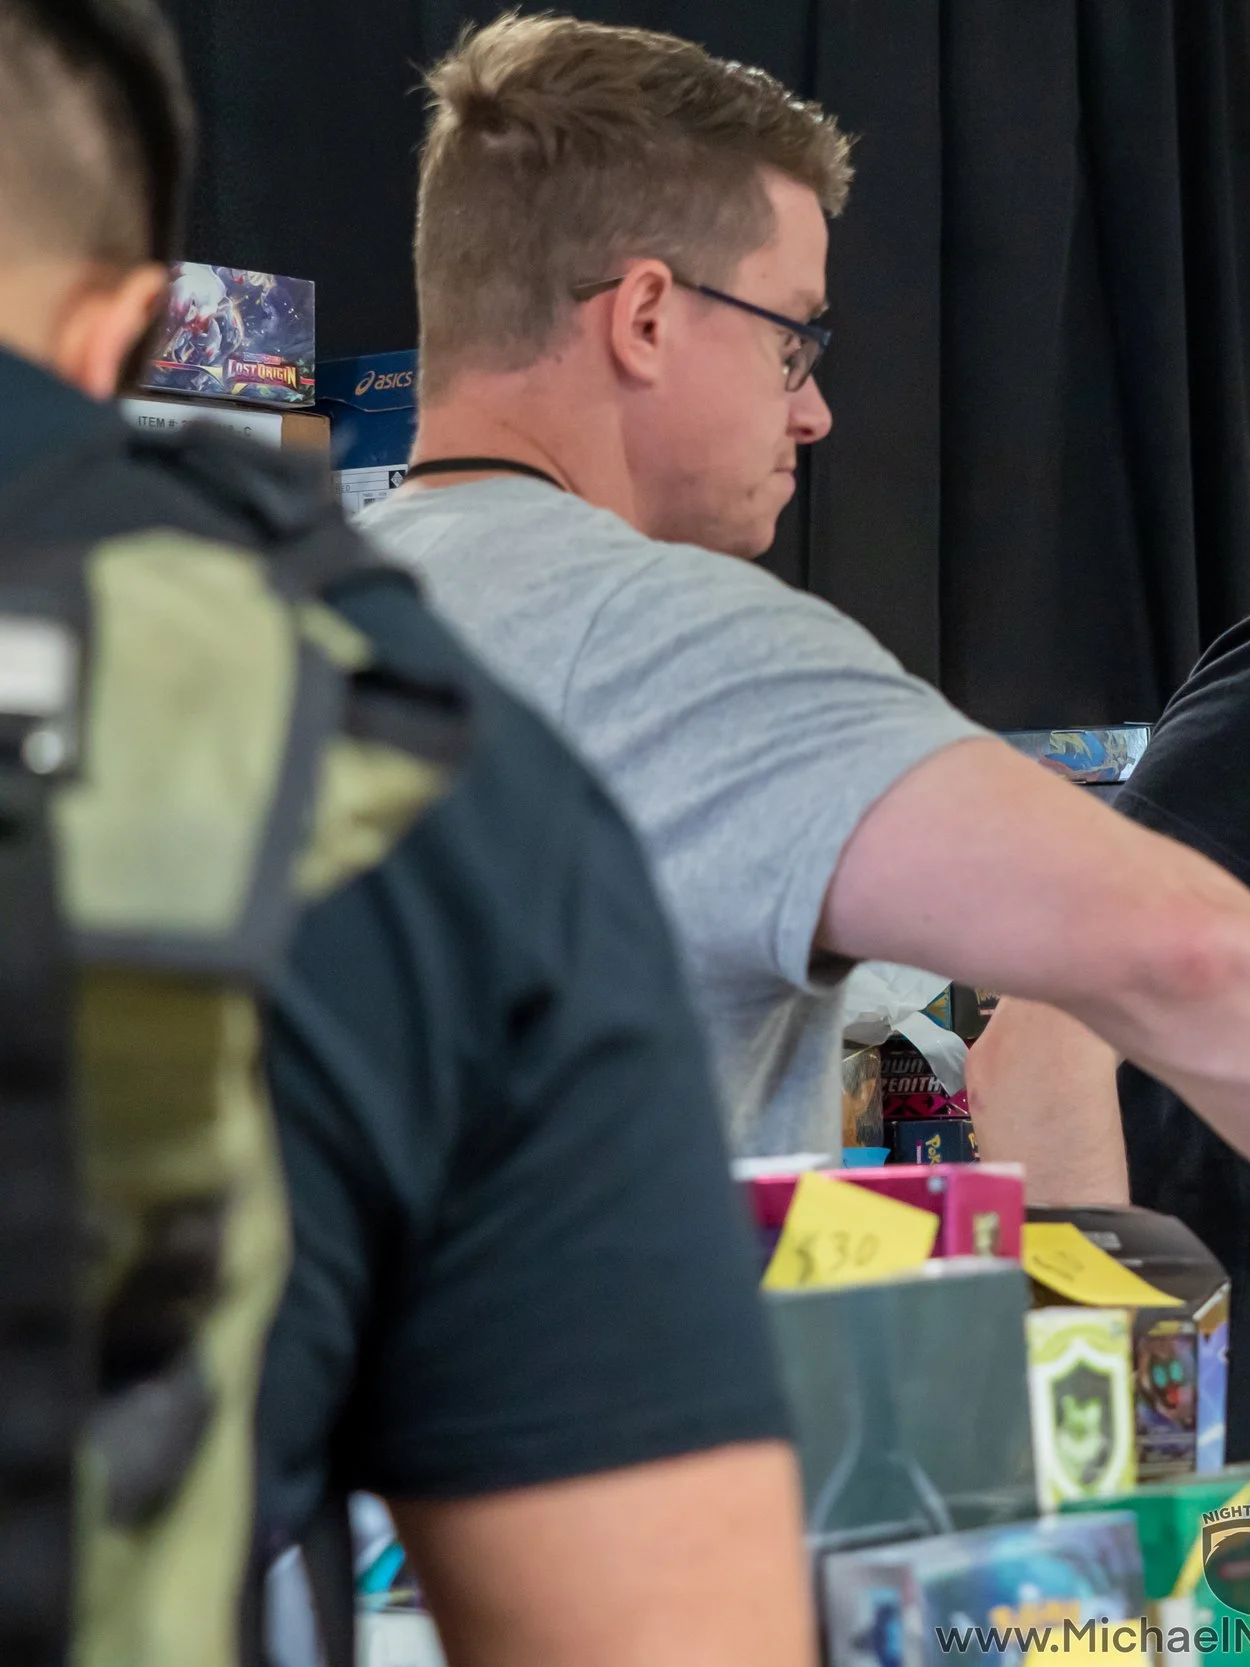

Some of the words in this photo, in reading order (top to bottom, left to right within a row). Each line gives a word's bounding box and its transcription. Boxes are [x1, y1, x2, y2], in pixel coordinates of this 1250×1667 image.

[228, 359, 257, 378] LOST
[257, 363, 297, 388] ORIGIN
[375, 371, 413, 390] asics
[138, 415, 166, 429] ITEM
